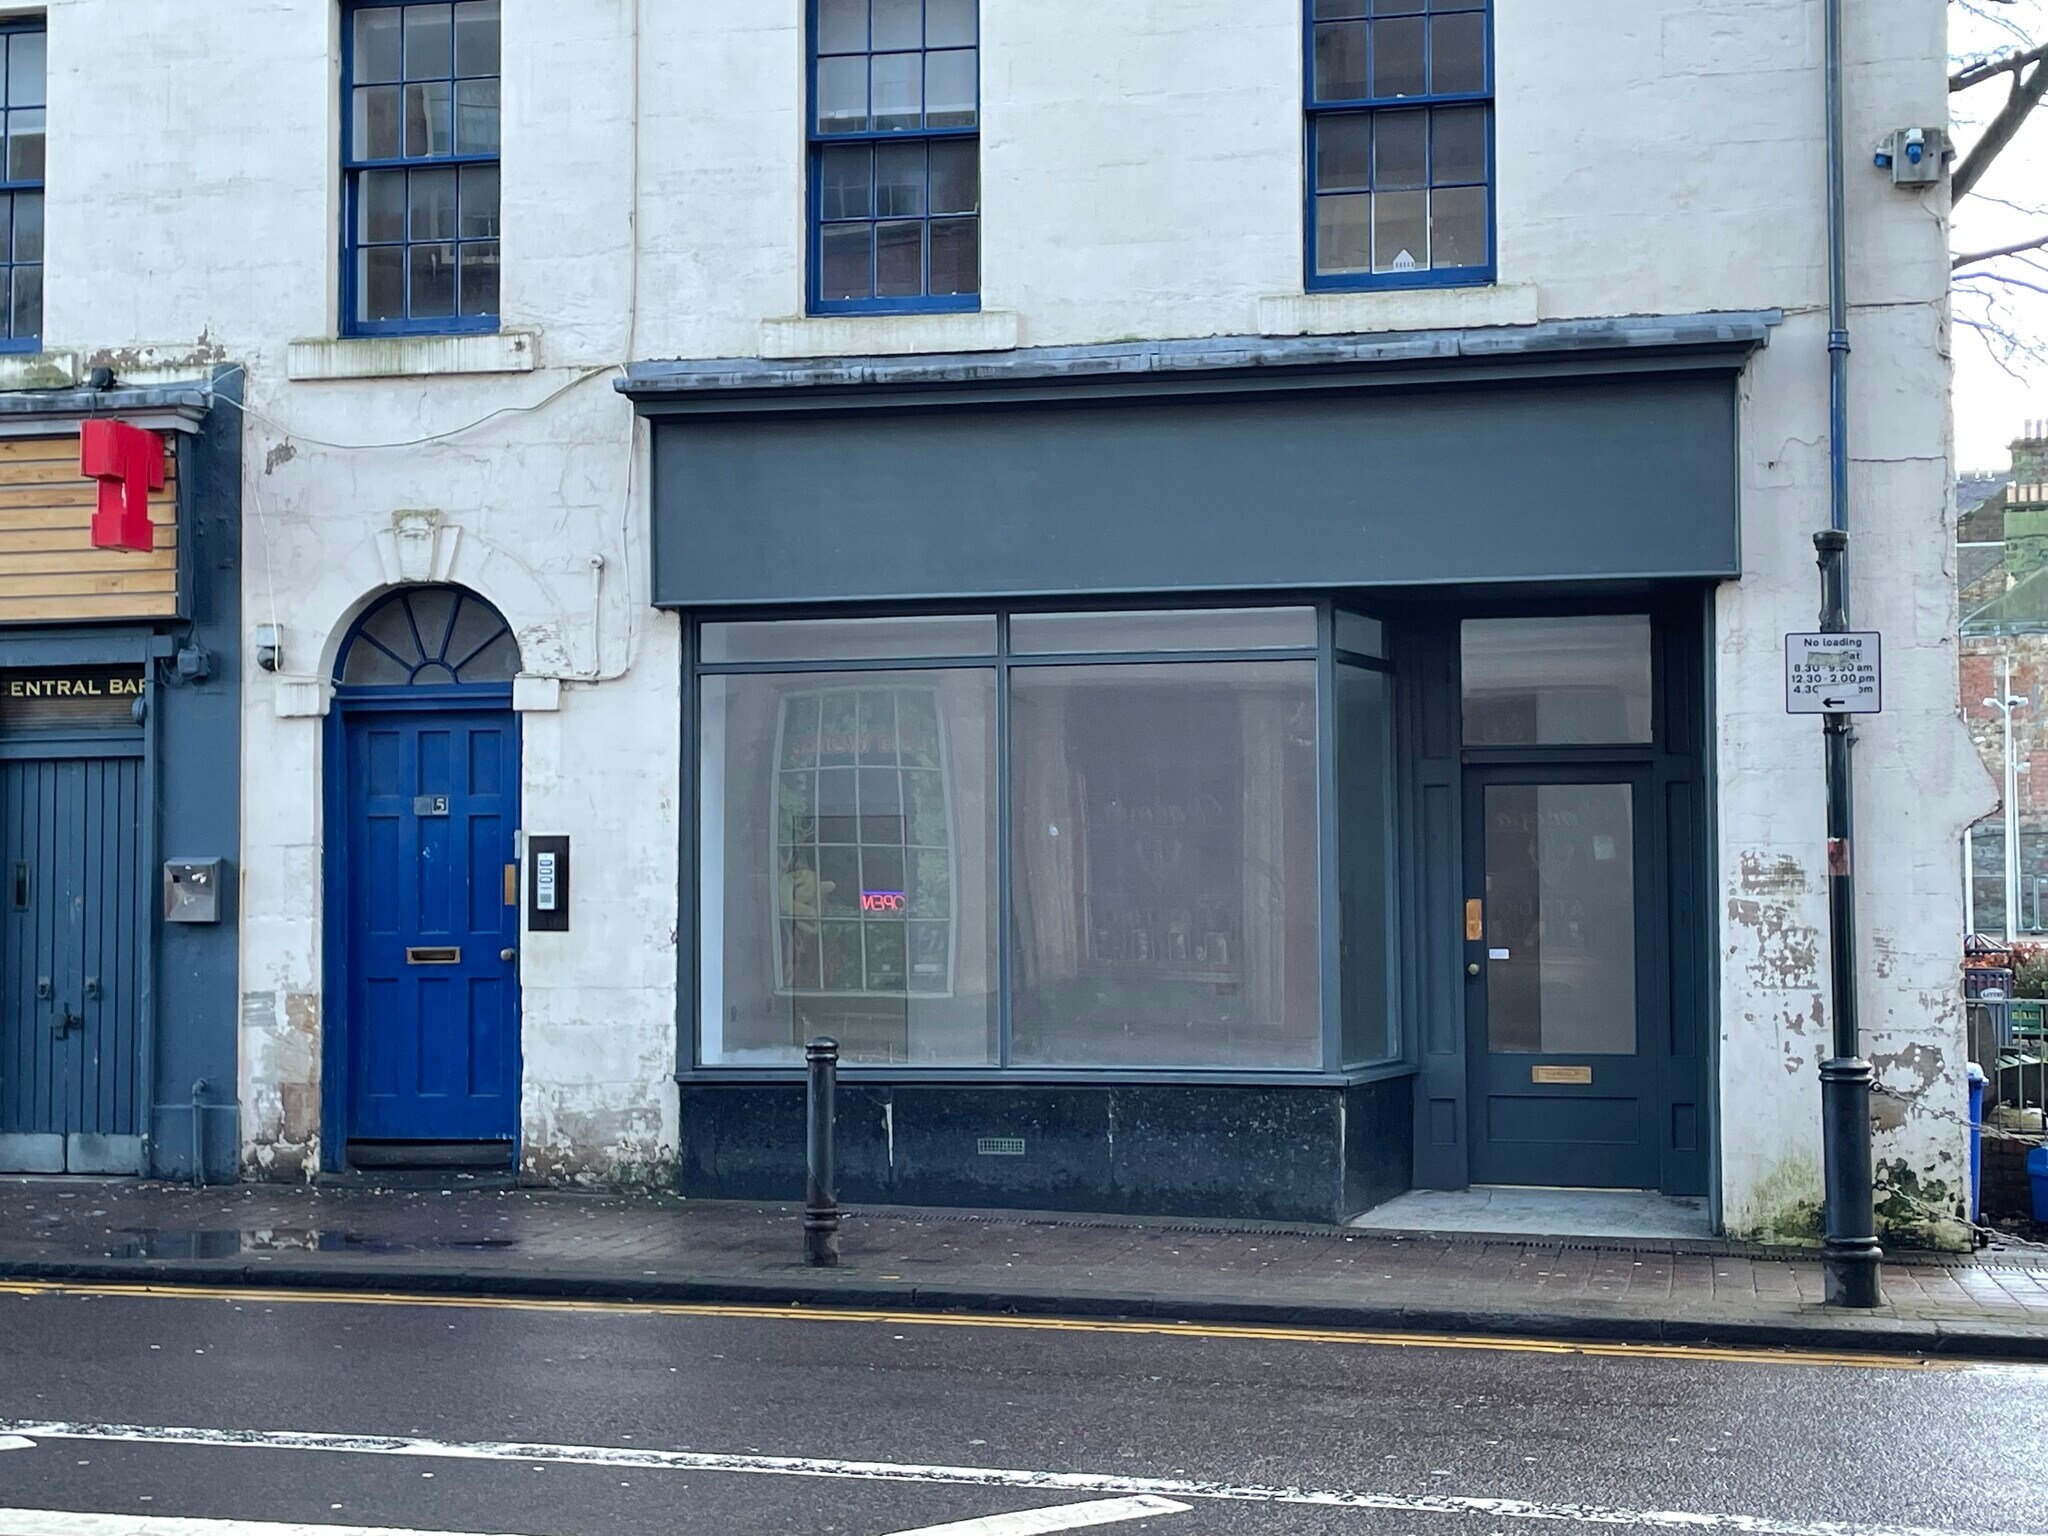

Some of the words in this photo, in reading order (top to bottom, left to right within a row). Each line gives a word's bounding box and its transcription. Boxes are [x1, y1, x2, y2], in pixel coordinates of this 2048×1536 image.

[1804, 638, 1819, 647] No
[1823, 638, 1862, 648] loading
[1792, 674, 1821, 683] 12.30
[1858, 675, 1875, 684] pm
[2, 679, 101, 697] ENTRAL
